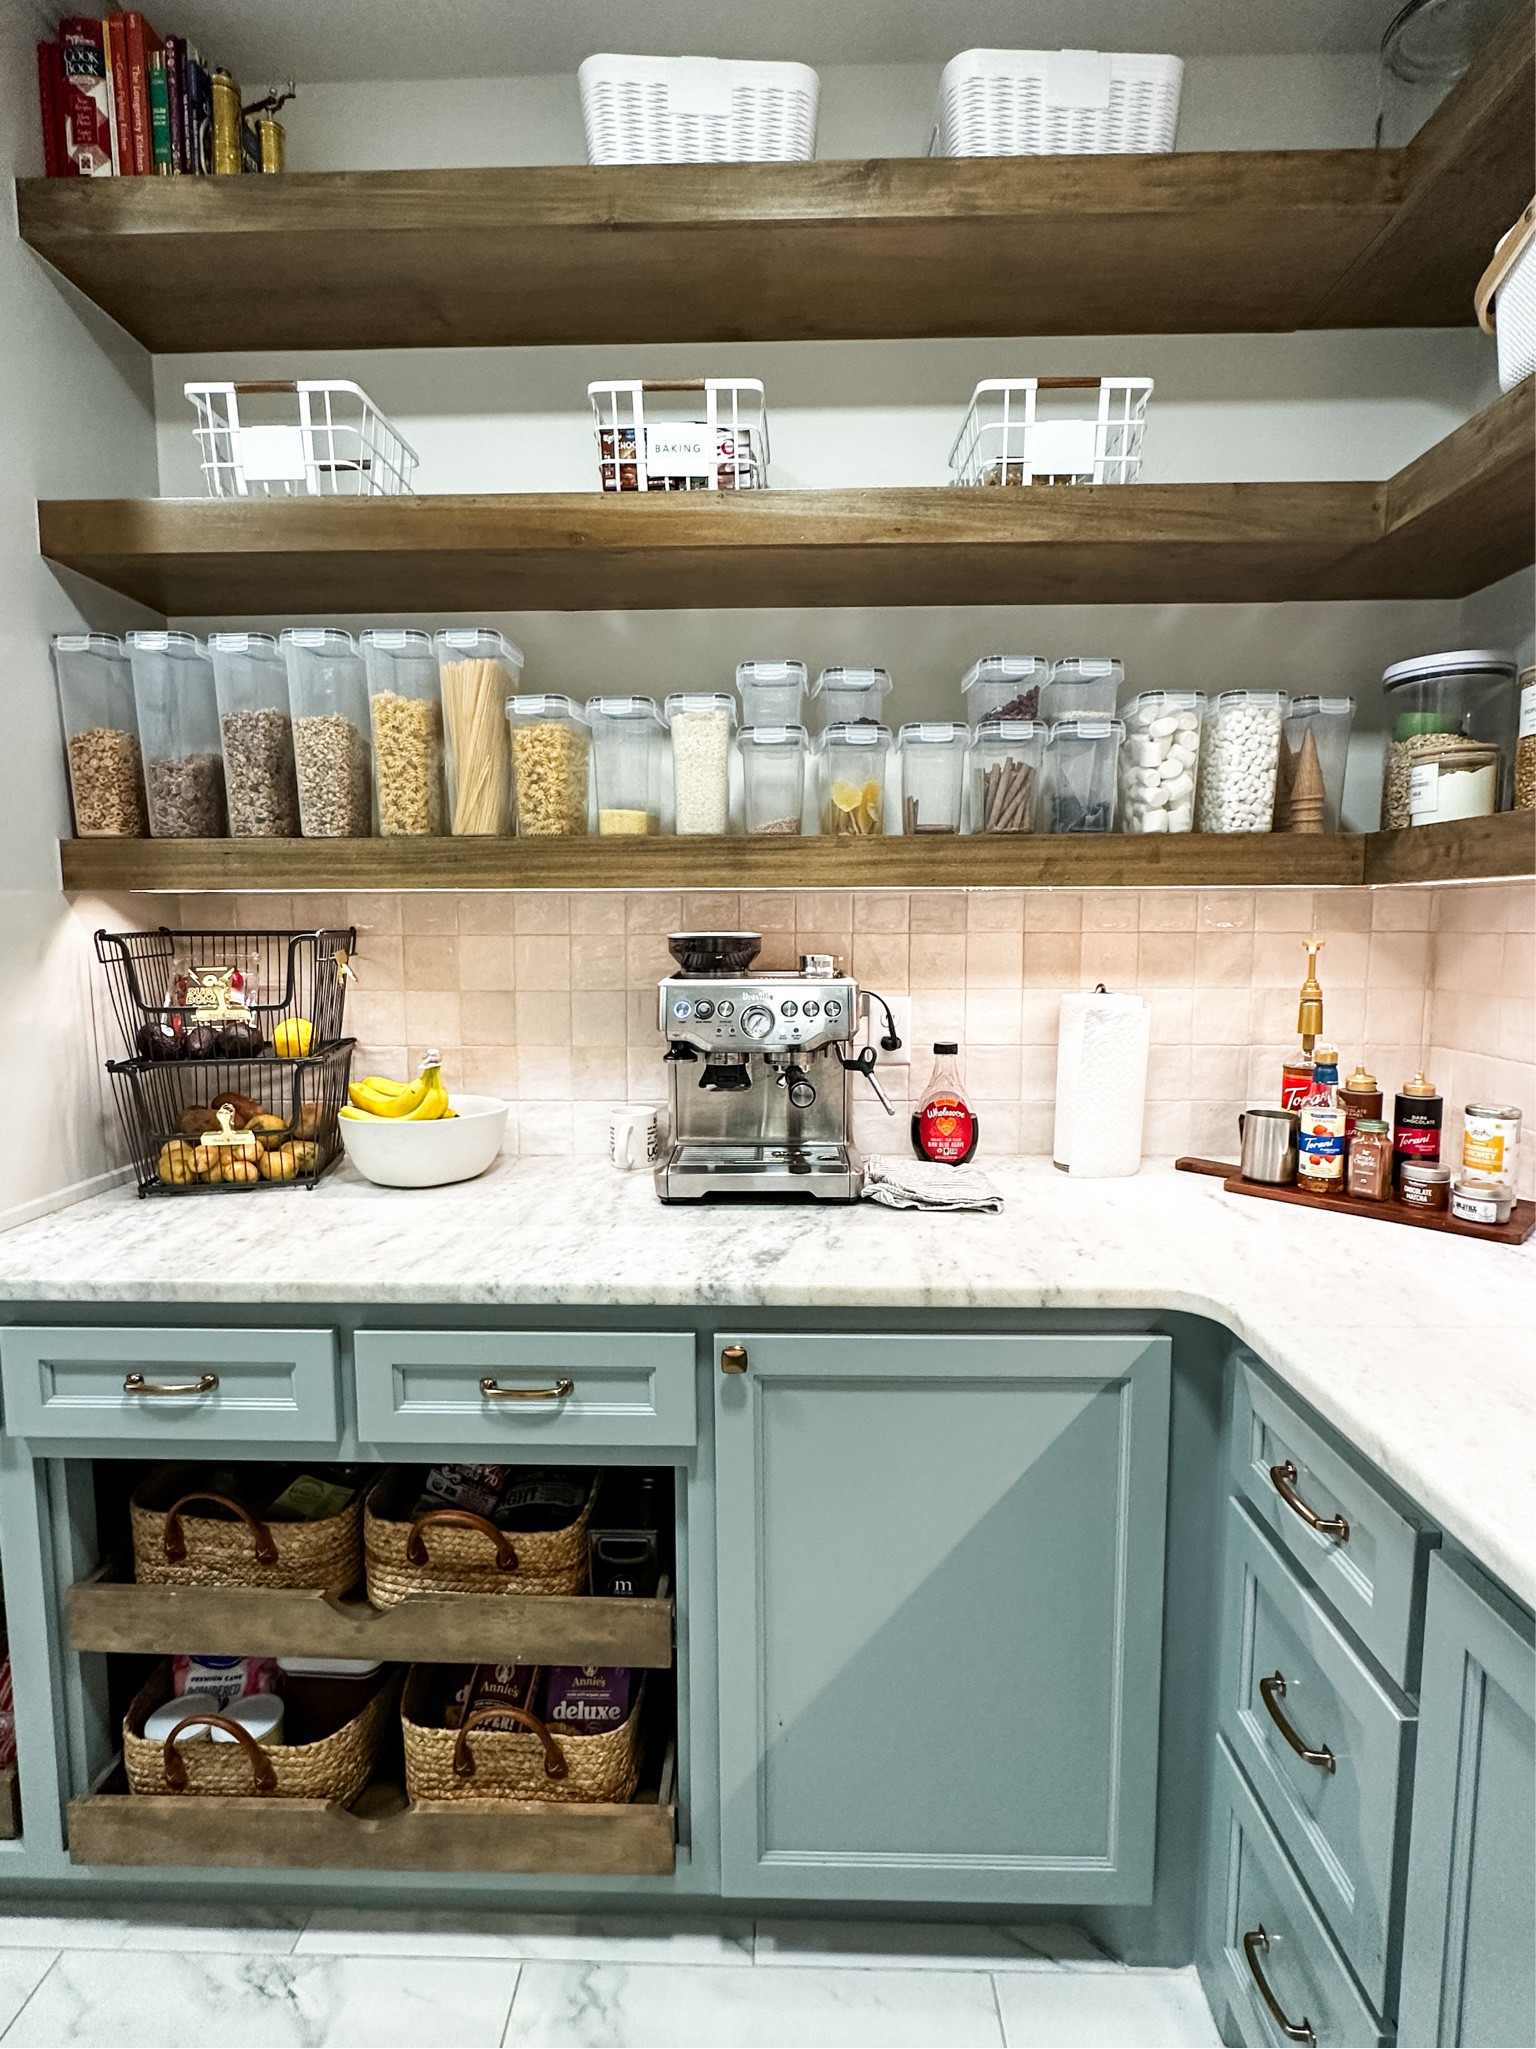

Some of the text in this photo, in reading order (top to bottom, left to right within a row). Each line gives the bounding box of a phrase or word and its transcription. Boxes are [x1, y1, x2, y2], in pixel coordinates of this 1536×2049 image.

[132, 65, 145, 172] The Longevity Kitchen
[655, 444, 701, 453] BAKING
[187, 987, 214, 996] SUG
[1304, 1137, 1334, 1151] Torani
[1398, 1133, 1430, 1147] Torani
[1403, 1185, 1432, 1196] CHOCOLATE
[1405, 1193, 1428, 1202] MATCHA
[615, 1580, 632, 1591] m
[572, 1676, 606, 1687] Annie's
[480, 1680, 520, 1698] Annie's
[552, 1700, 621, 1720] deluxe
